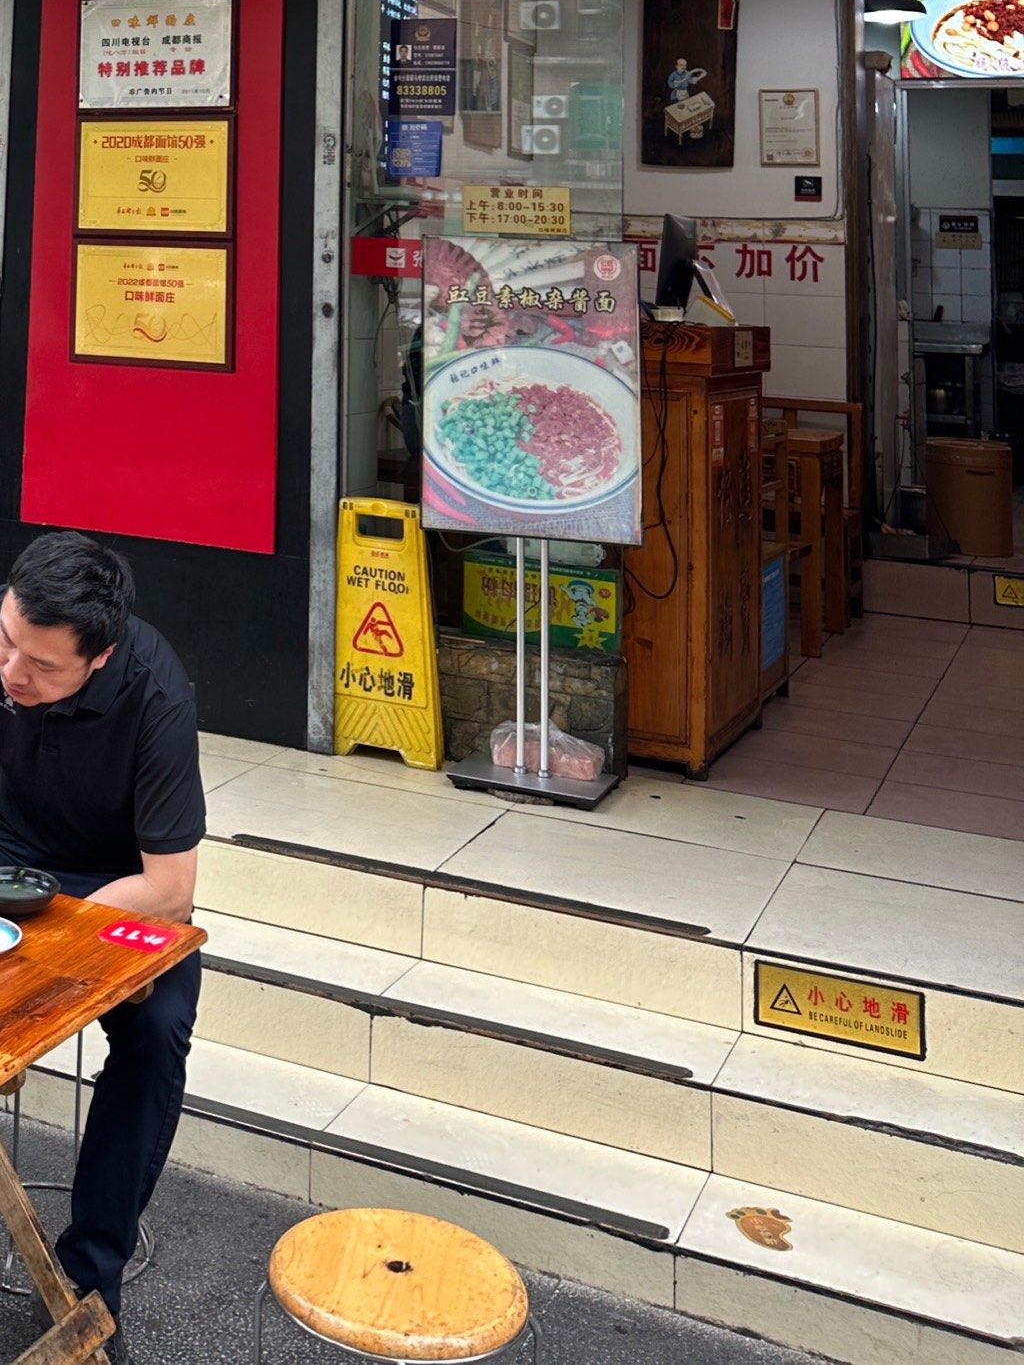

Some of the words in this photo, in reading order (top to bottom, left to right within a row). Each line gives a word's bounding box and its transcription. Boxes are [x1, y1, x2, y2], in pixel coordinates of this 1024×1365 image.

[101, 36, 151, 47] 四川电视台
[162, 34, 203, 45] 成都商报
[97, 59, 206, 78] 特别推荐品牌
[396, 85, 447, 96] 83338805
[101, 134, 206, 149] 2020成都面馆50强
[490, 187, 543, 199] 营业时间
[124, 291, 175, 303] 口味鲜面庄
[447, 284, 617, 314] 豇豆素椒杂酱面
[353, 564, 406, 582] CAUTION
[346, 575, 371, 589] WET
[340, 662, 415, 700] 小心地滑
[807, 985, 910, 1025] 小心地滑
[808, 1011, 818, 1021] BE
[819, 1013, 853, 1028] CAREFUL
[854, 1020, 864, 1030] OF
[864, 1023, 908, 1040] LANDSLIDE
